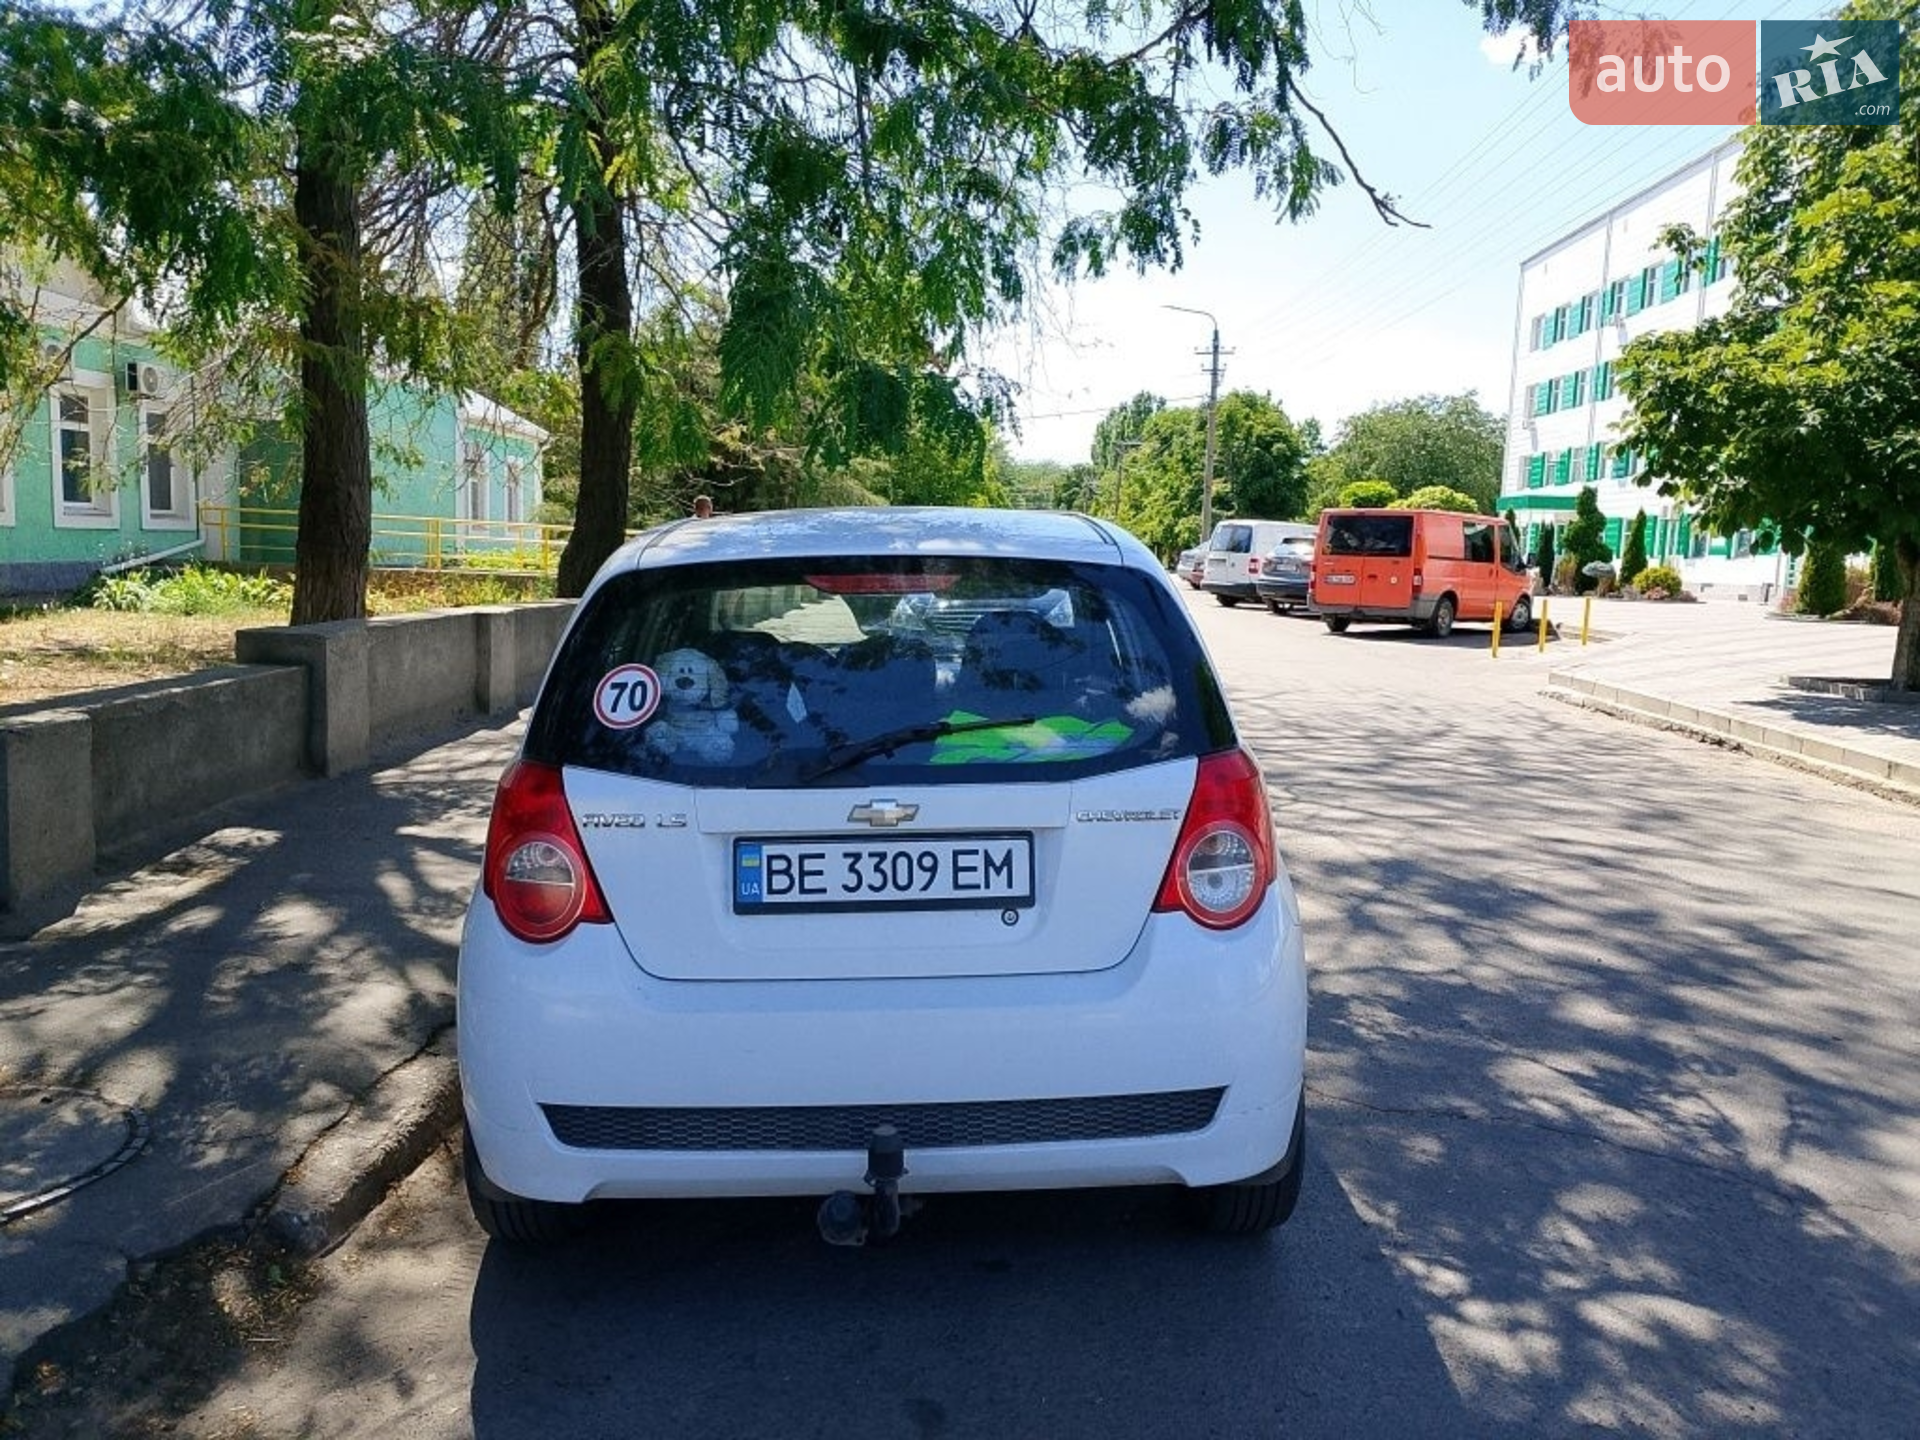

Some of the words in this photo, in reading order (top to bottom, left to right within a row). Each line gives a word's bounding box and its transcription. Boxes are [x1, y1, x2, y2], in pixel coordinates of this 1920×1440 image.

[610, 680, 648, 713] 70
[582, 813, 646, 828] AVEO
[656, 813, 687, 828] LS
[1076, 808, 1181, 822] CHEVROLET
[766, 852, 828, 895] BE
[841, 850, 939, 894] 3309
[952, 848, 1014, 891] EM
[741, 882, 760, 895] UA
